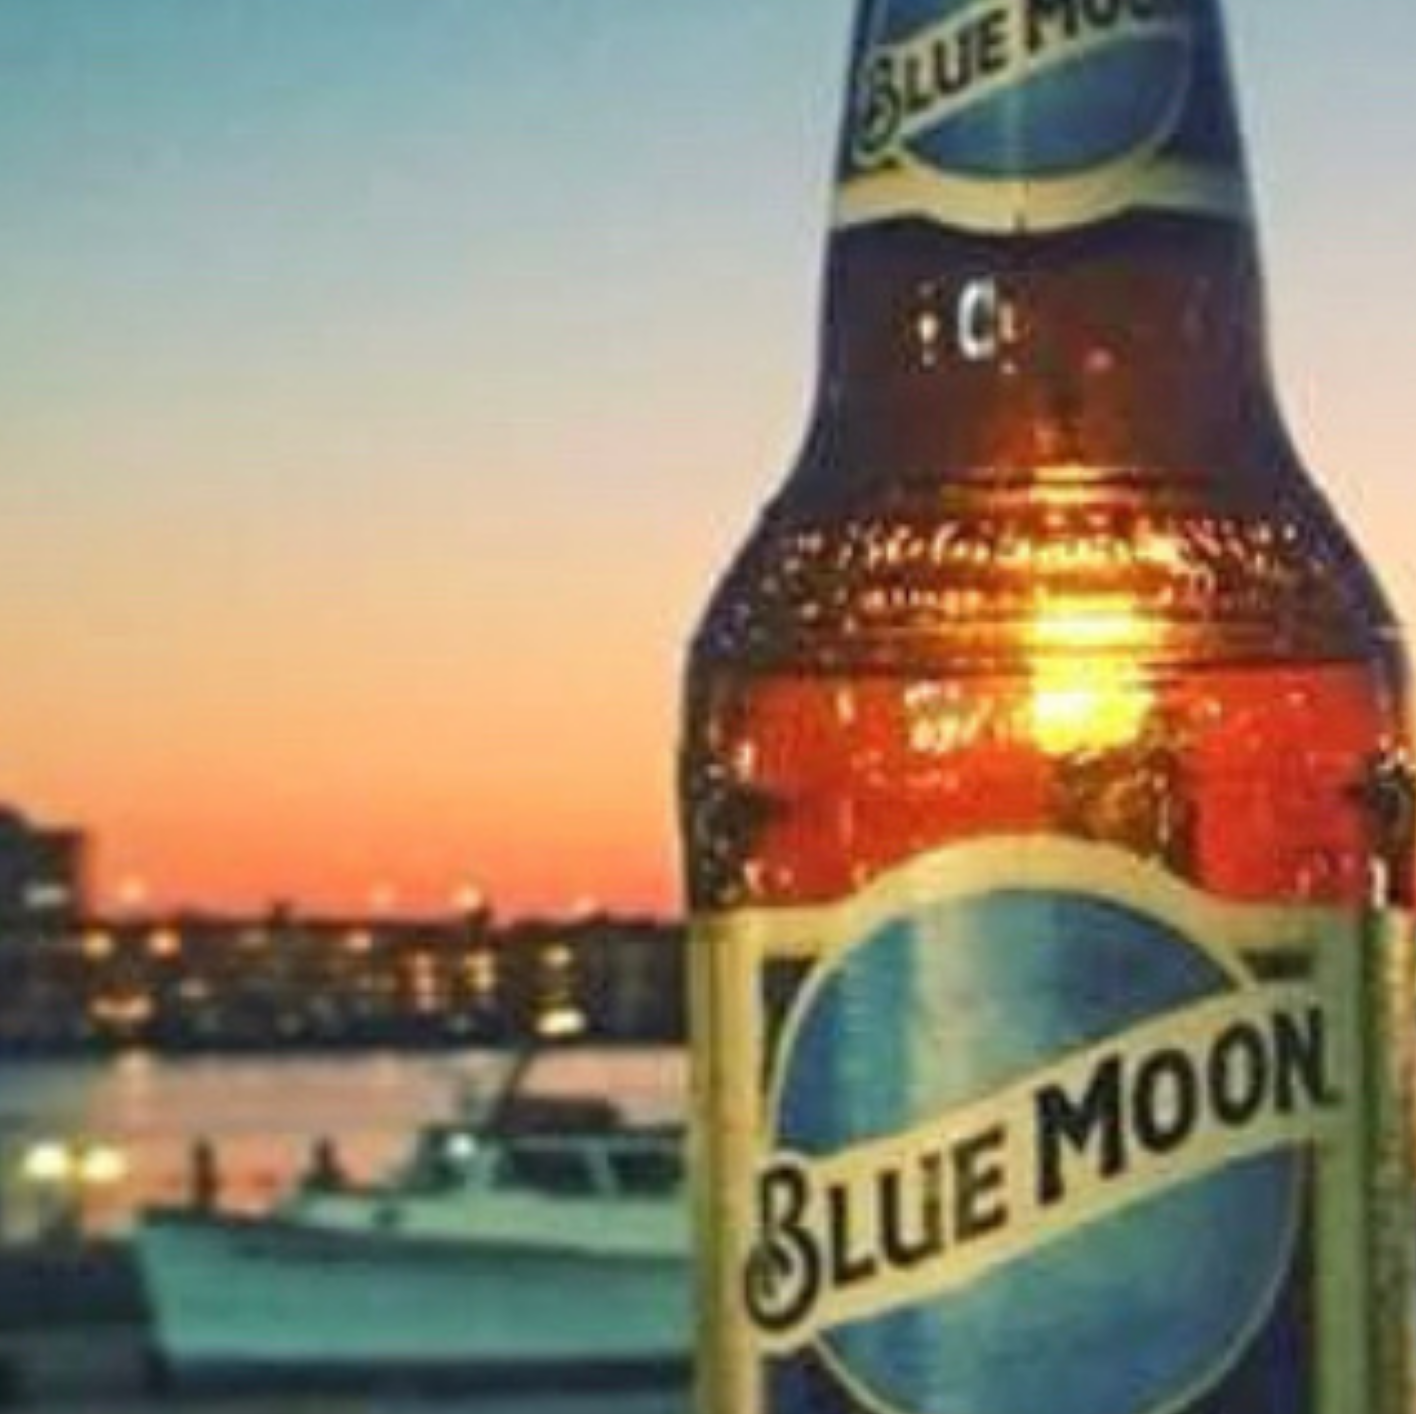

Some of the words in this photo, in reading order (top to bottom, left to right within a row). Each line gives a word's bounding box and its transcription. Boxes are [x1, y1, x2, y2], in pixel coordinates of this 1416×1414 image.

[856, 8, 1009, 156] BLUE
[743, 1123, 1007, 1331] BLUE
[1033, 1007, 1340, 1205] MOON
